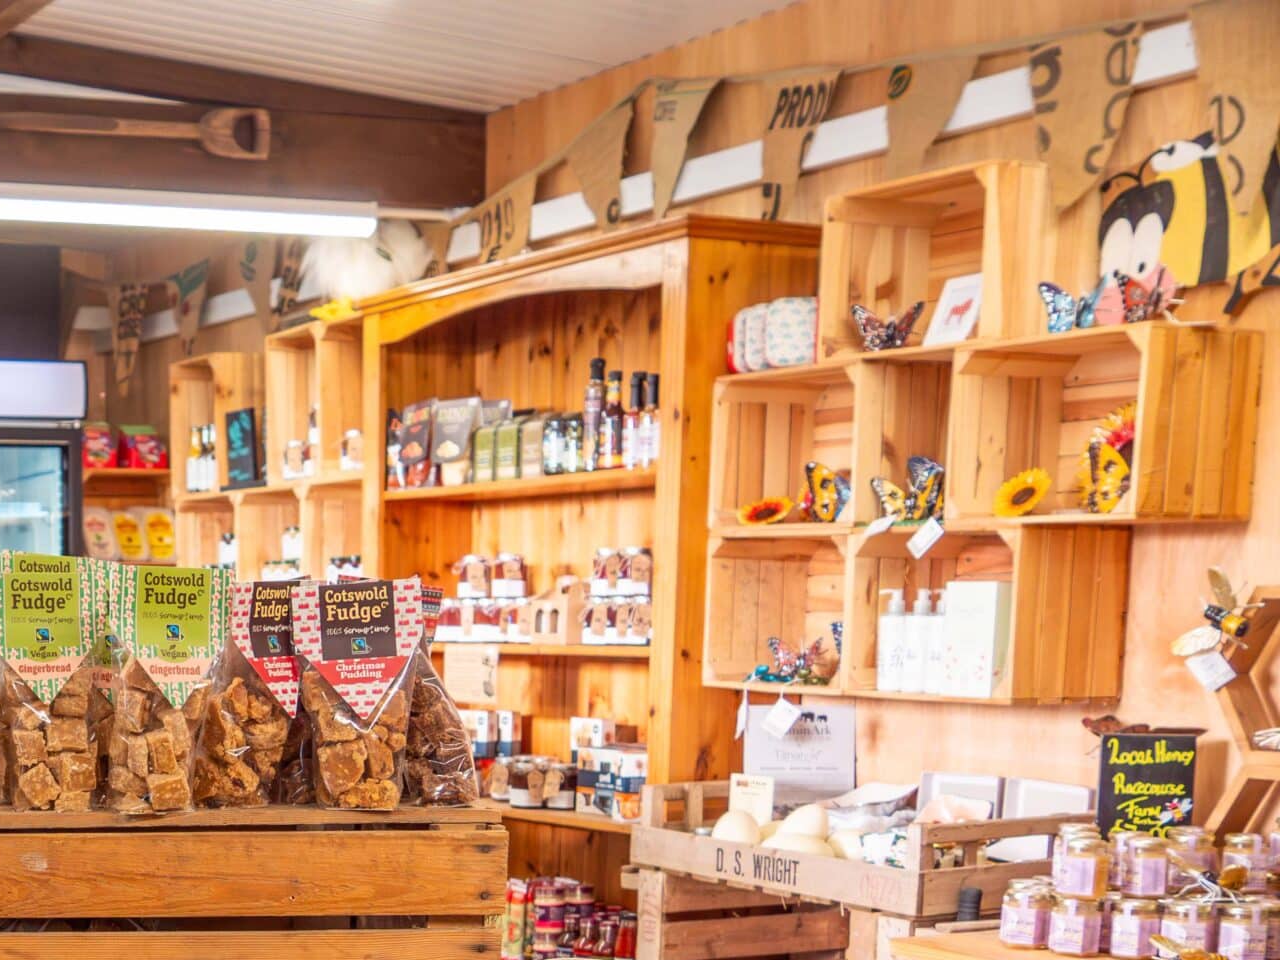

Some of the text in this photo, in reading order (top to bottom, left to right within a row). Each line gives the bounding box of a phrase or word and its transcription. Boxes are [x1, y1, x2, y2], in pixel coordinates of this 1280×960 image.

[19, 560, 70, 573] Cotswold
[10, 578, 72, 591] Cotswold
[144, 572, 205, 587] Cotswold
[144, 588, 197, 609] Fudge
[255, 585, 290, 600] Cotswol
[325, 585, 388, 603] Cotswold
[11, 594, 65, 613] Fudge
[254, 602, 288, 621] Fudge
[326, 604, 382, 622] Fudge
[30, 651, 58, 659] Vegan
[161, 649, 187, 659] Vegan
[18, 664, 71, 674] Gingerbread
[150, 664, 200, 676] Gingerbread
[336, 662, 385, 672] Christmas
[340, 670, 382, 679] Pudding
[1108, 737, 1195, 765] Local Honey
[753, 853, 800, 886] WRIGHT
